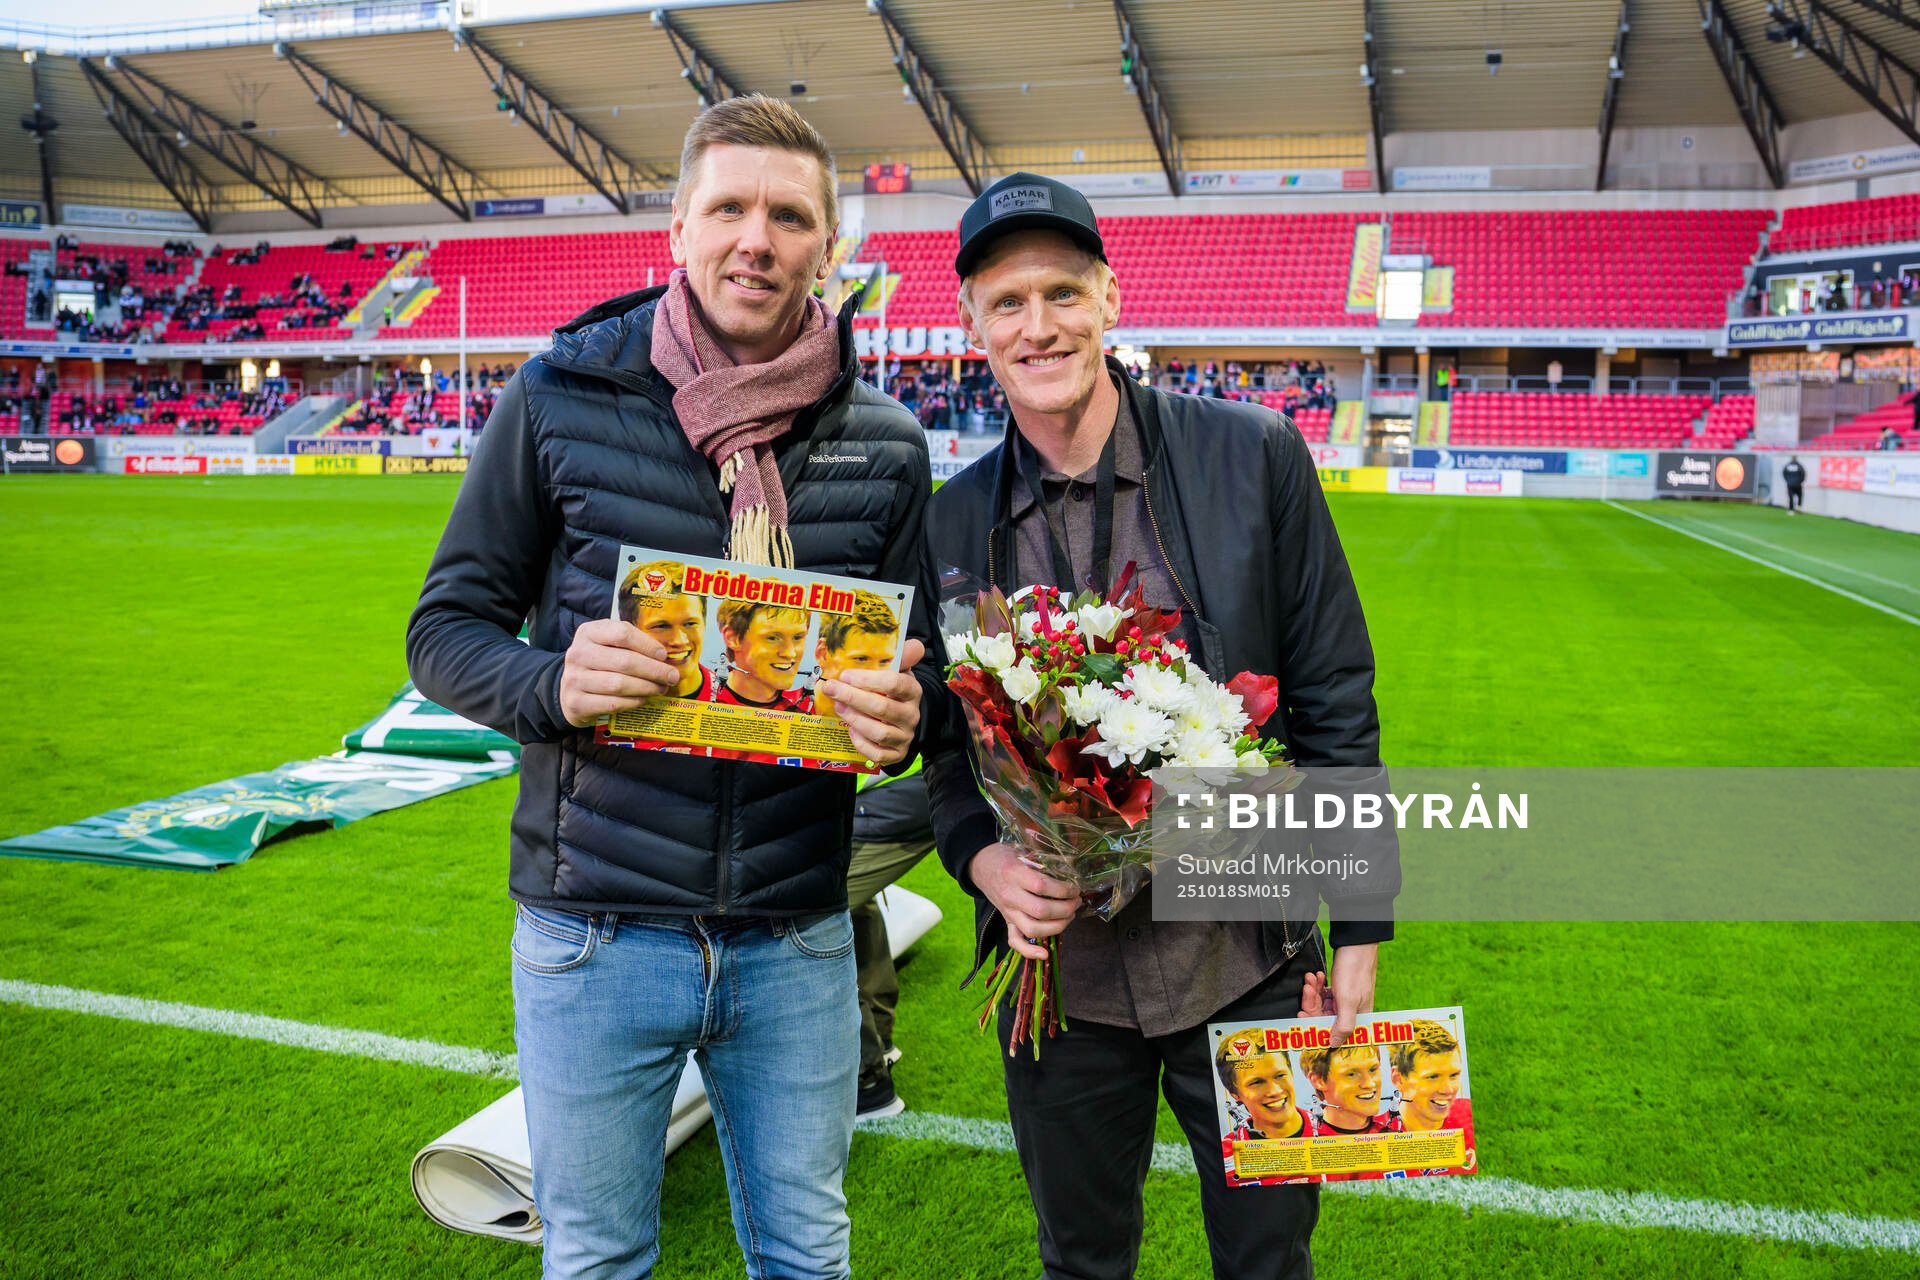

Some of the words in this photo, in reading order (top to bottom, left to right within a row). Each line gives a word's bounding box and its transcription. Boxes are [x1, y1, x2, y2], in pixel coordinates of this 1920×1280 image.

[1202, 175, 1222, 186] IVT
[995, 190, 1045, 207] KALMAR
[853, 326, 986, 356] KUR
[314, 457, 358, 469] HYLTE
[684, 566, 804, 606] Bröderna
[808, 583, 854, 613] Elm
[706, 704, 735, 714] Rasmus
[754, 710, 794, 721] Spelgeniet!
[800, 716, 822, 724] David
[1265, 1025, 1368, 1051] Brödena
[1372, 1021, 1413, 1043] Elm
